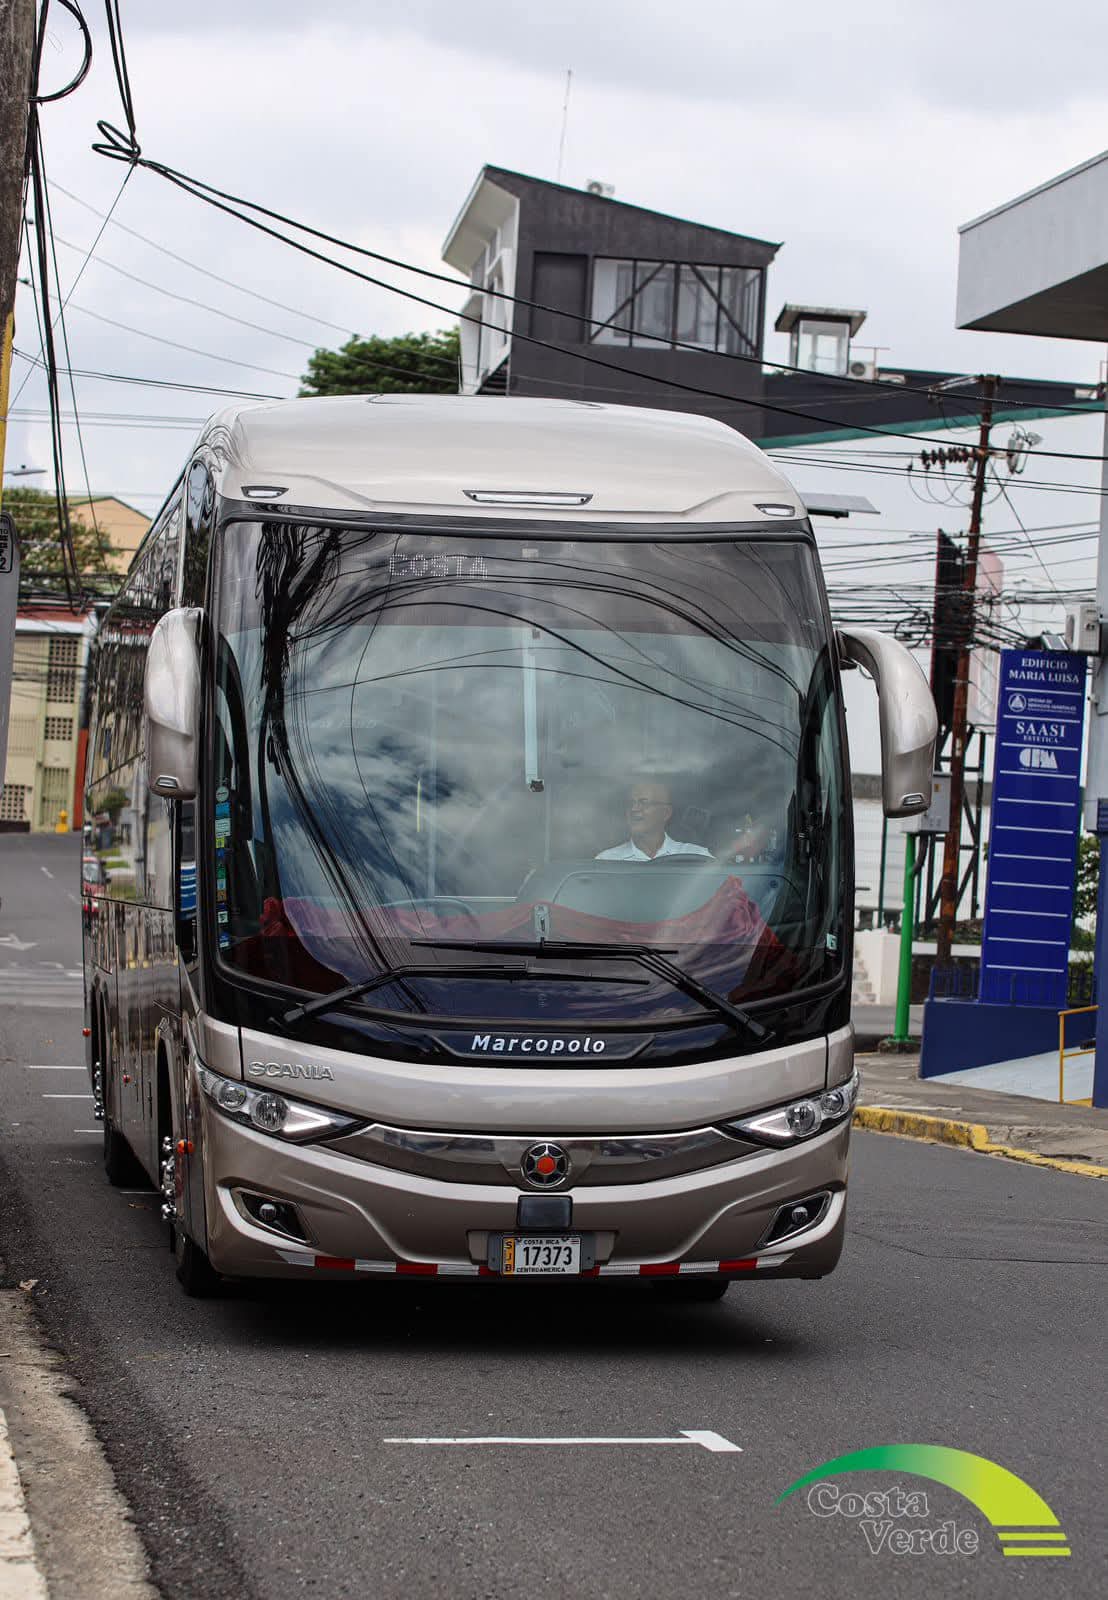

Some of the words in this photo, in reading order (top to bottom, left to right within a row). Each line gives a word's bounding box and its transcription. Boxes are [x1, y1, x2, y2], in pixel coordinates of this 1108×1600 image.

[389, 554, 488, 578] COSTA
[1021, 657, 1068, 670] EDIFICIO
[1008, 669, 1046, 681] MARIA
[1048, 672, 1080, 684] LUISA
[1015, 721, 1066, 738] SAASI
[471, 1034, 606, 1055] Marcopolo
[247, 1060, 336, 1082] SCANIA
[523, 1246, 573, 1266] 17373
